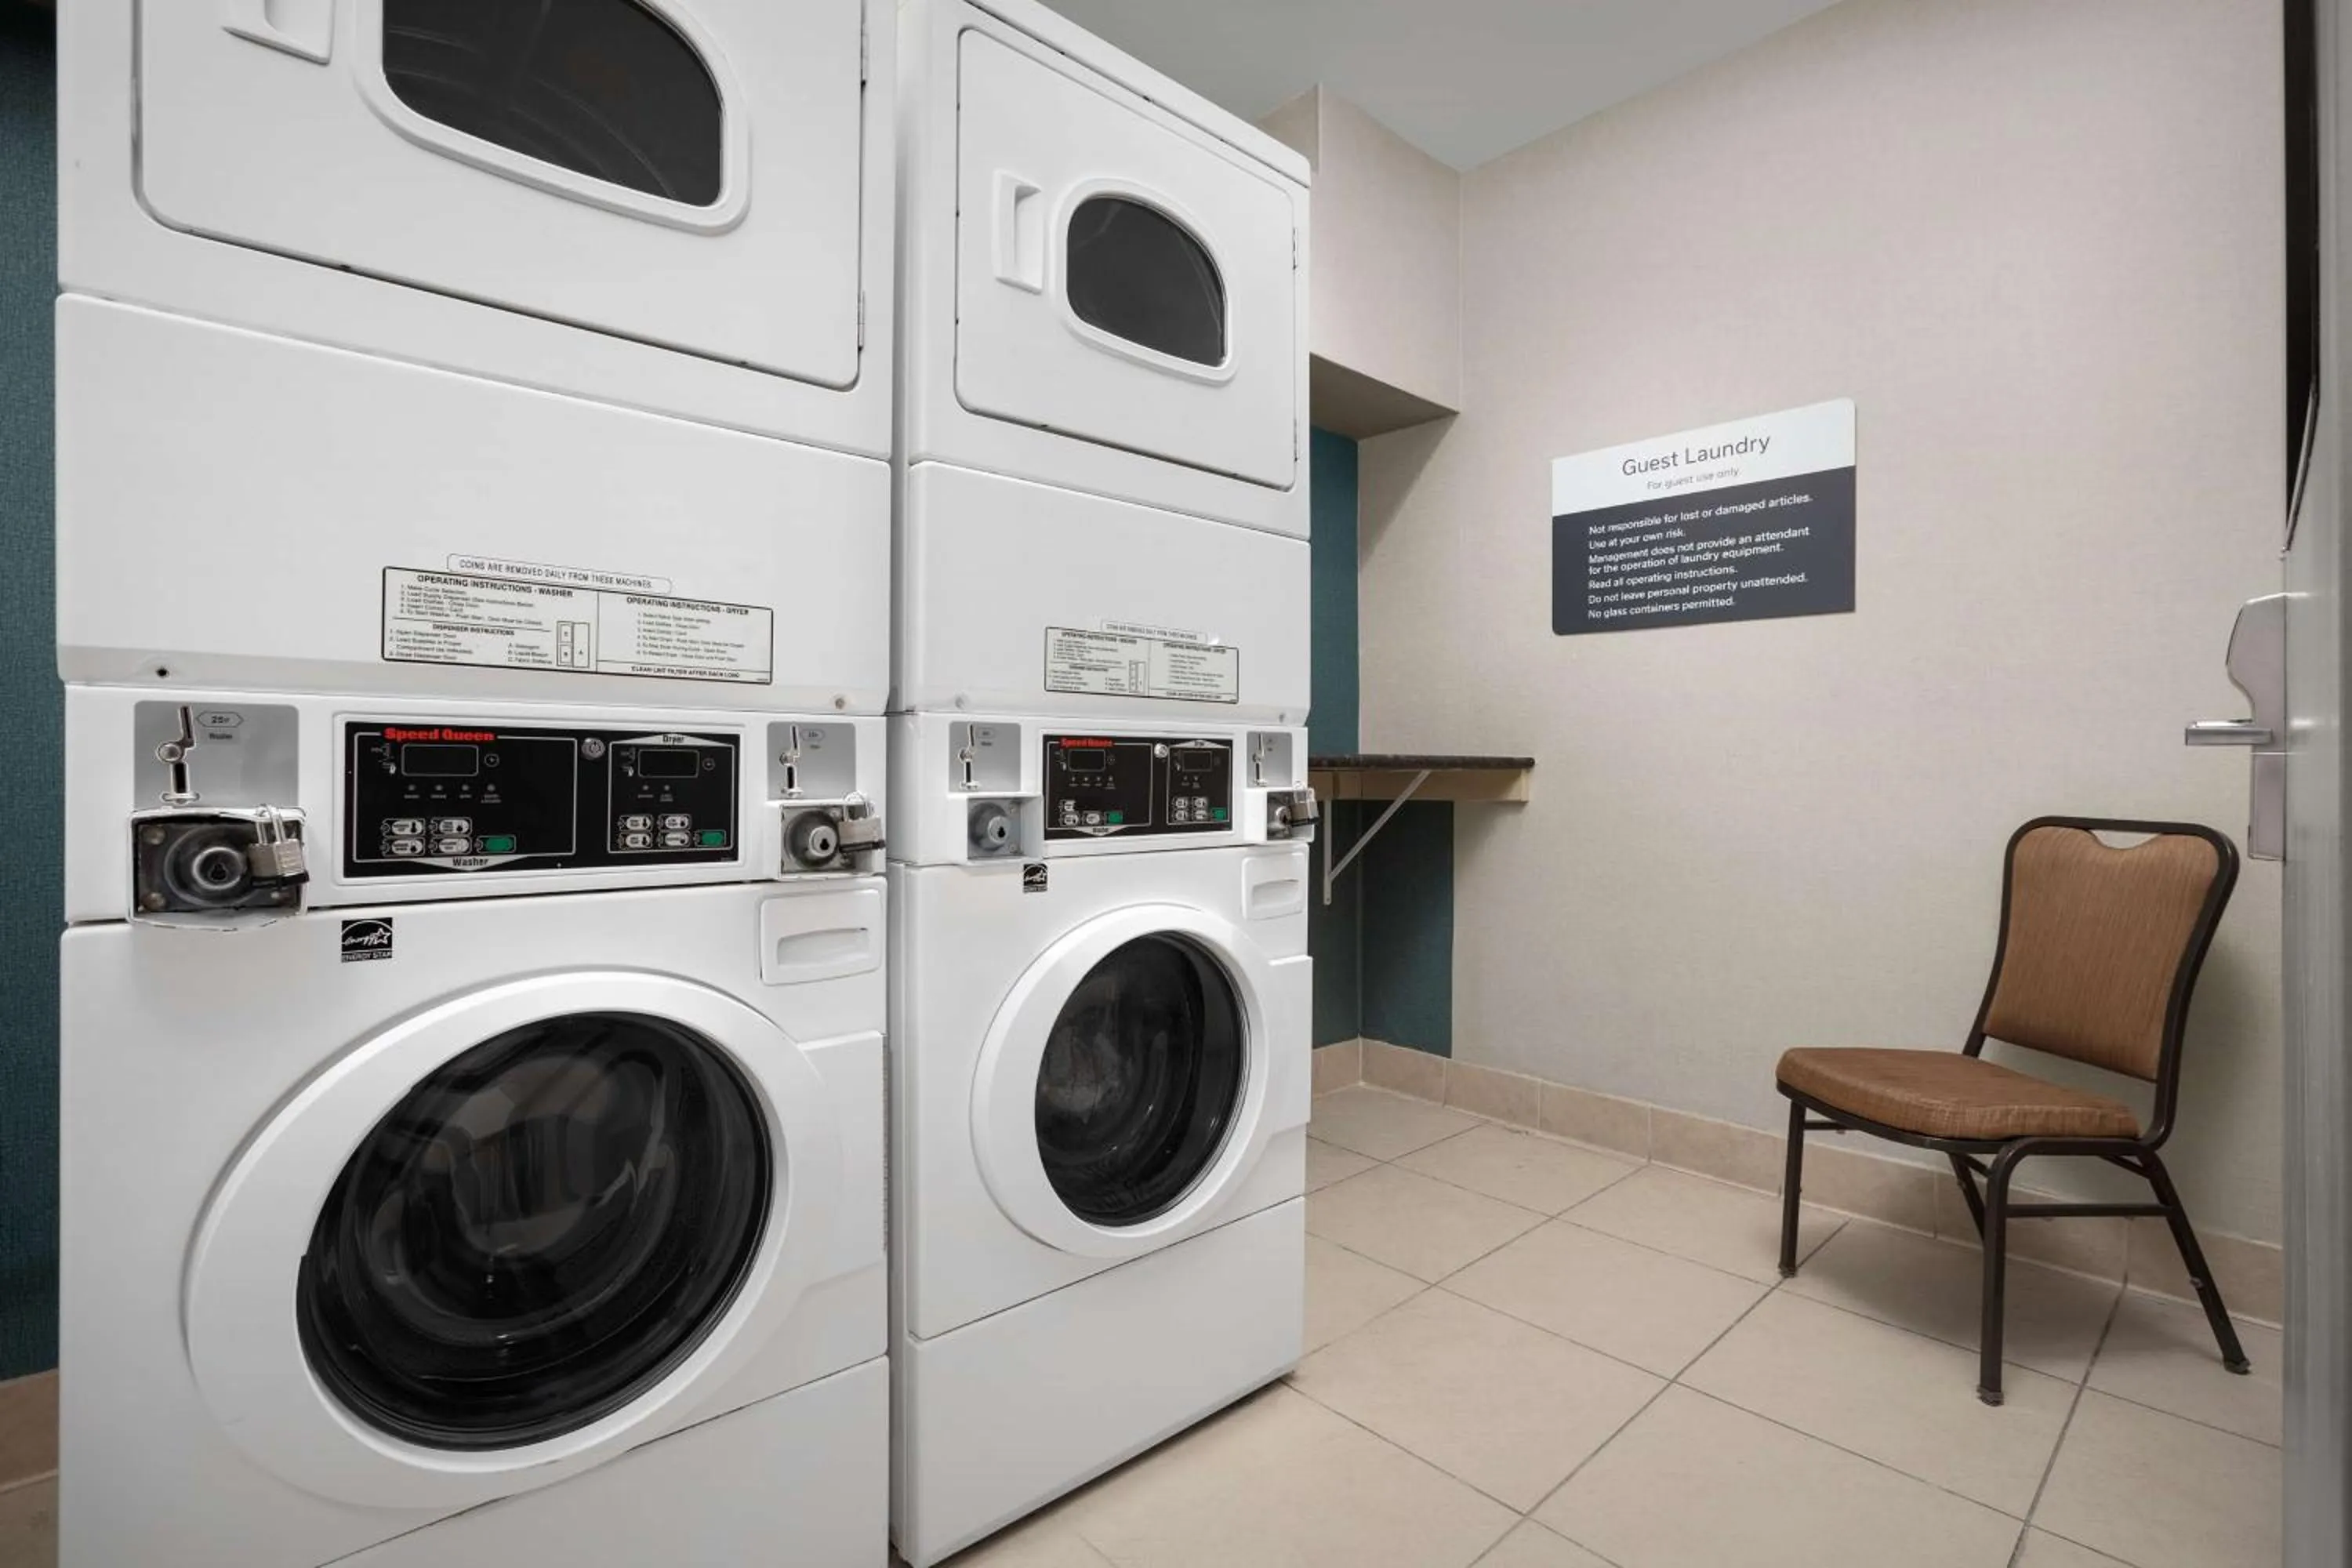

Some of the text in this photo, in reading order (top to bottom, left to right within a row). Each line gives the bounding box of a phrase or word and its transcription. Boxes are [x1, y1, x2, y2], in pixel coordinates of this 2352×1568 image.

[1622, 435, 1770, 476] Guest Laundry
[1647, 481, 1662, 490] For
[1664, 476, 1693, 489] guest
[1697, 474, 1714, 482] use
[1589, 494, 1813, 535] Not responsible for lost or damaged articles.
[1588, 528, 1686, 550] Use at your own risk.
[1588, 527, 1809, 564] Management does not provide an attendant
[1588, 543, 1784, 575] for the operation of laundry equipment.
[459, 559, 485, 571] COINS
[488, 562, 502, 573] ARE
[505, 564, 542, 577] REMOVED
[545, 568, 567, 580] DAILY
[568, 572, 589, 582] FROM
[591, 574, 614, 585] THESE
[1588, 565, 1738, 590] Read all operating instructions.
[417, 575, 468, 587] OPERATING
[470, 579, 532, 593] INSTRUCTIONS
[539, 587, 573, 598] WASHER
[1588, 572, 1809, 604] Do not leave personal property unattended.
[626, 597, 668, 608] OPERATING
[670, 601, 720, 613] INSTRUCTIONS
[1588, 597, 1735, 619] No glass containers permitted.
[384, 728, 495, 742] Speed Queen
[662, 734, 684, 745] Dryer
[452, 858, 489, 866] Washer
